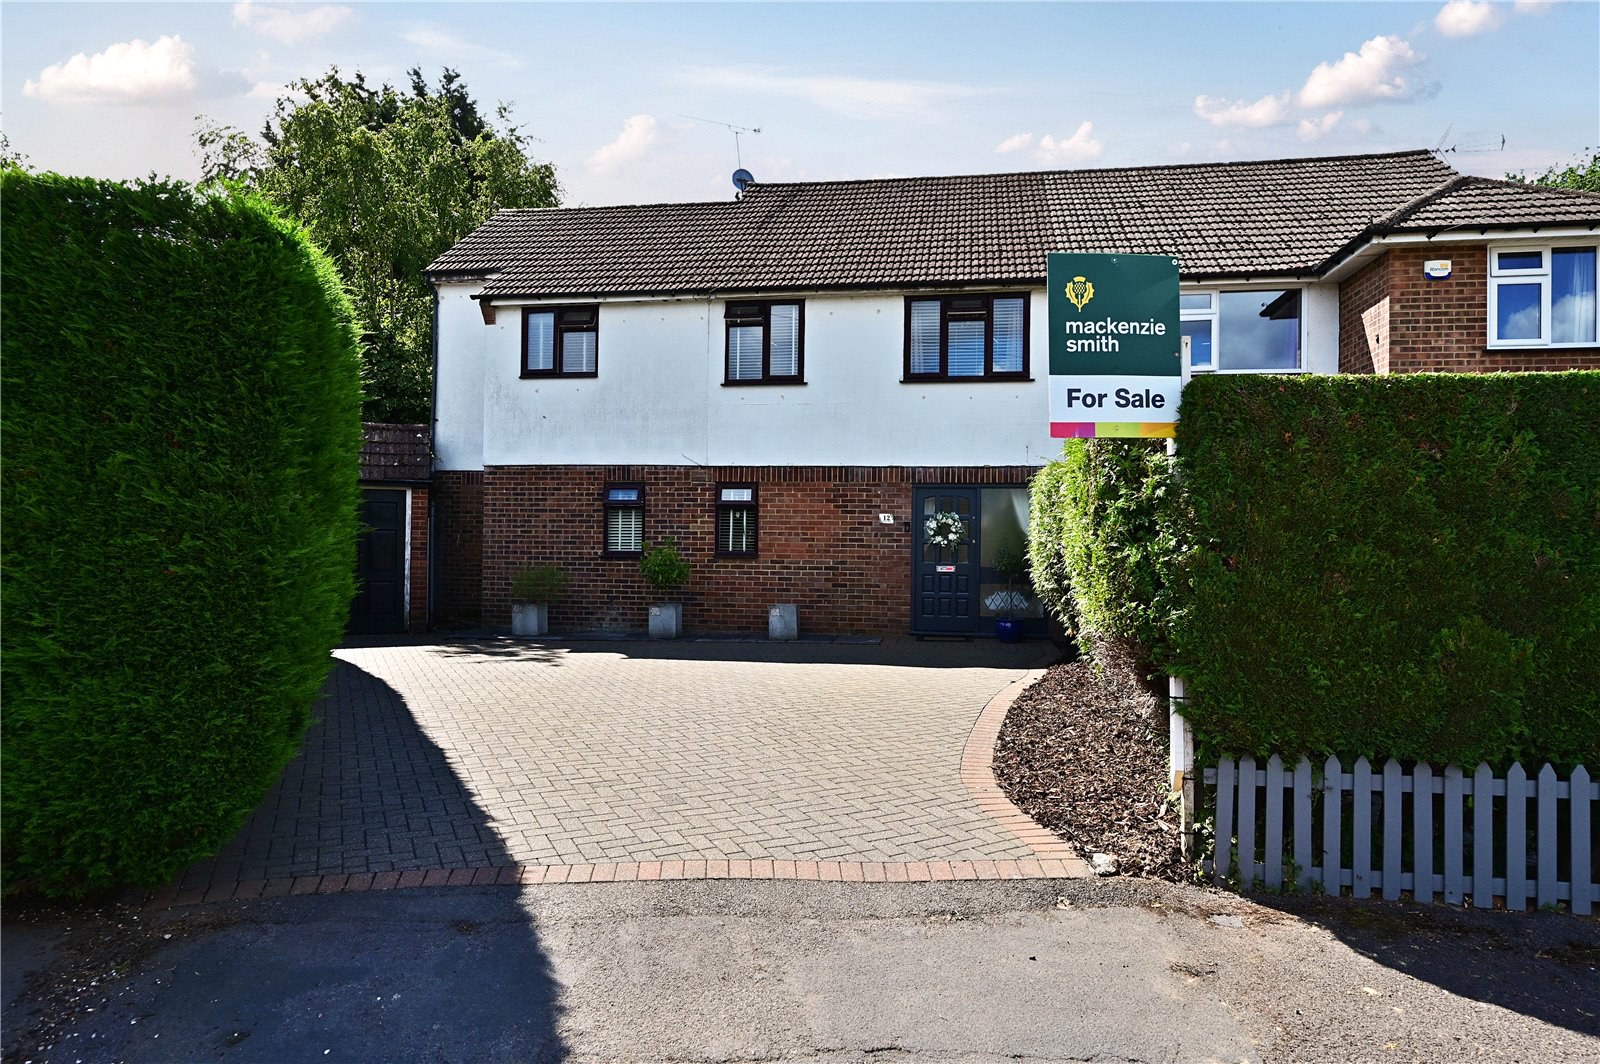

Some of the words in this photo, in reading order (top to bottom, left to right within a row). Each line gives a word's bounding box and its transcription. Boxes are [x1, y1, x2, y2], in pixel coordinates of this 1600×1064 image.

[1065, 316, 1167, 336] mackenzie
[1066, 335, 1119, 352] smith
[1066, 388, 1108, 408] For
[1114, 387, 1166, 409] Sale
